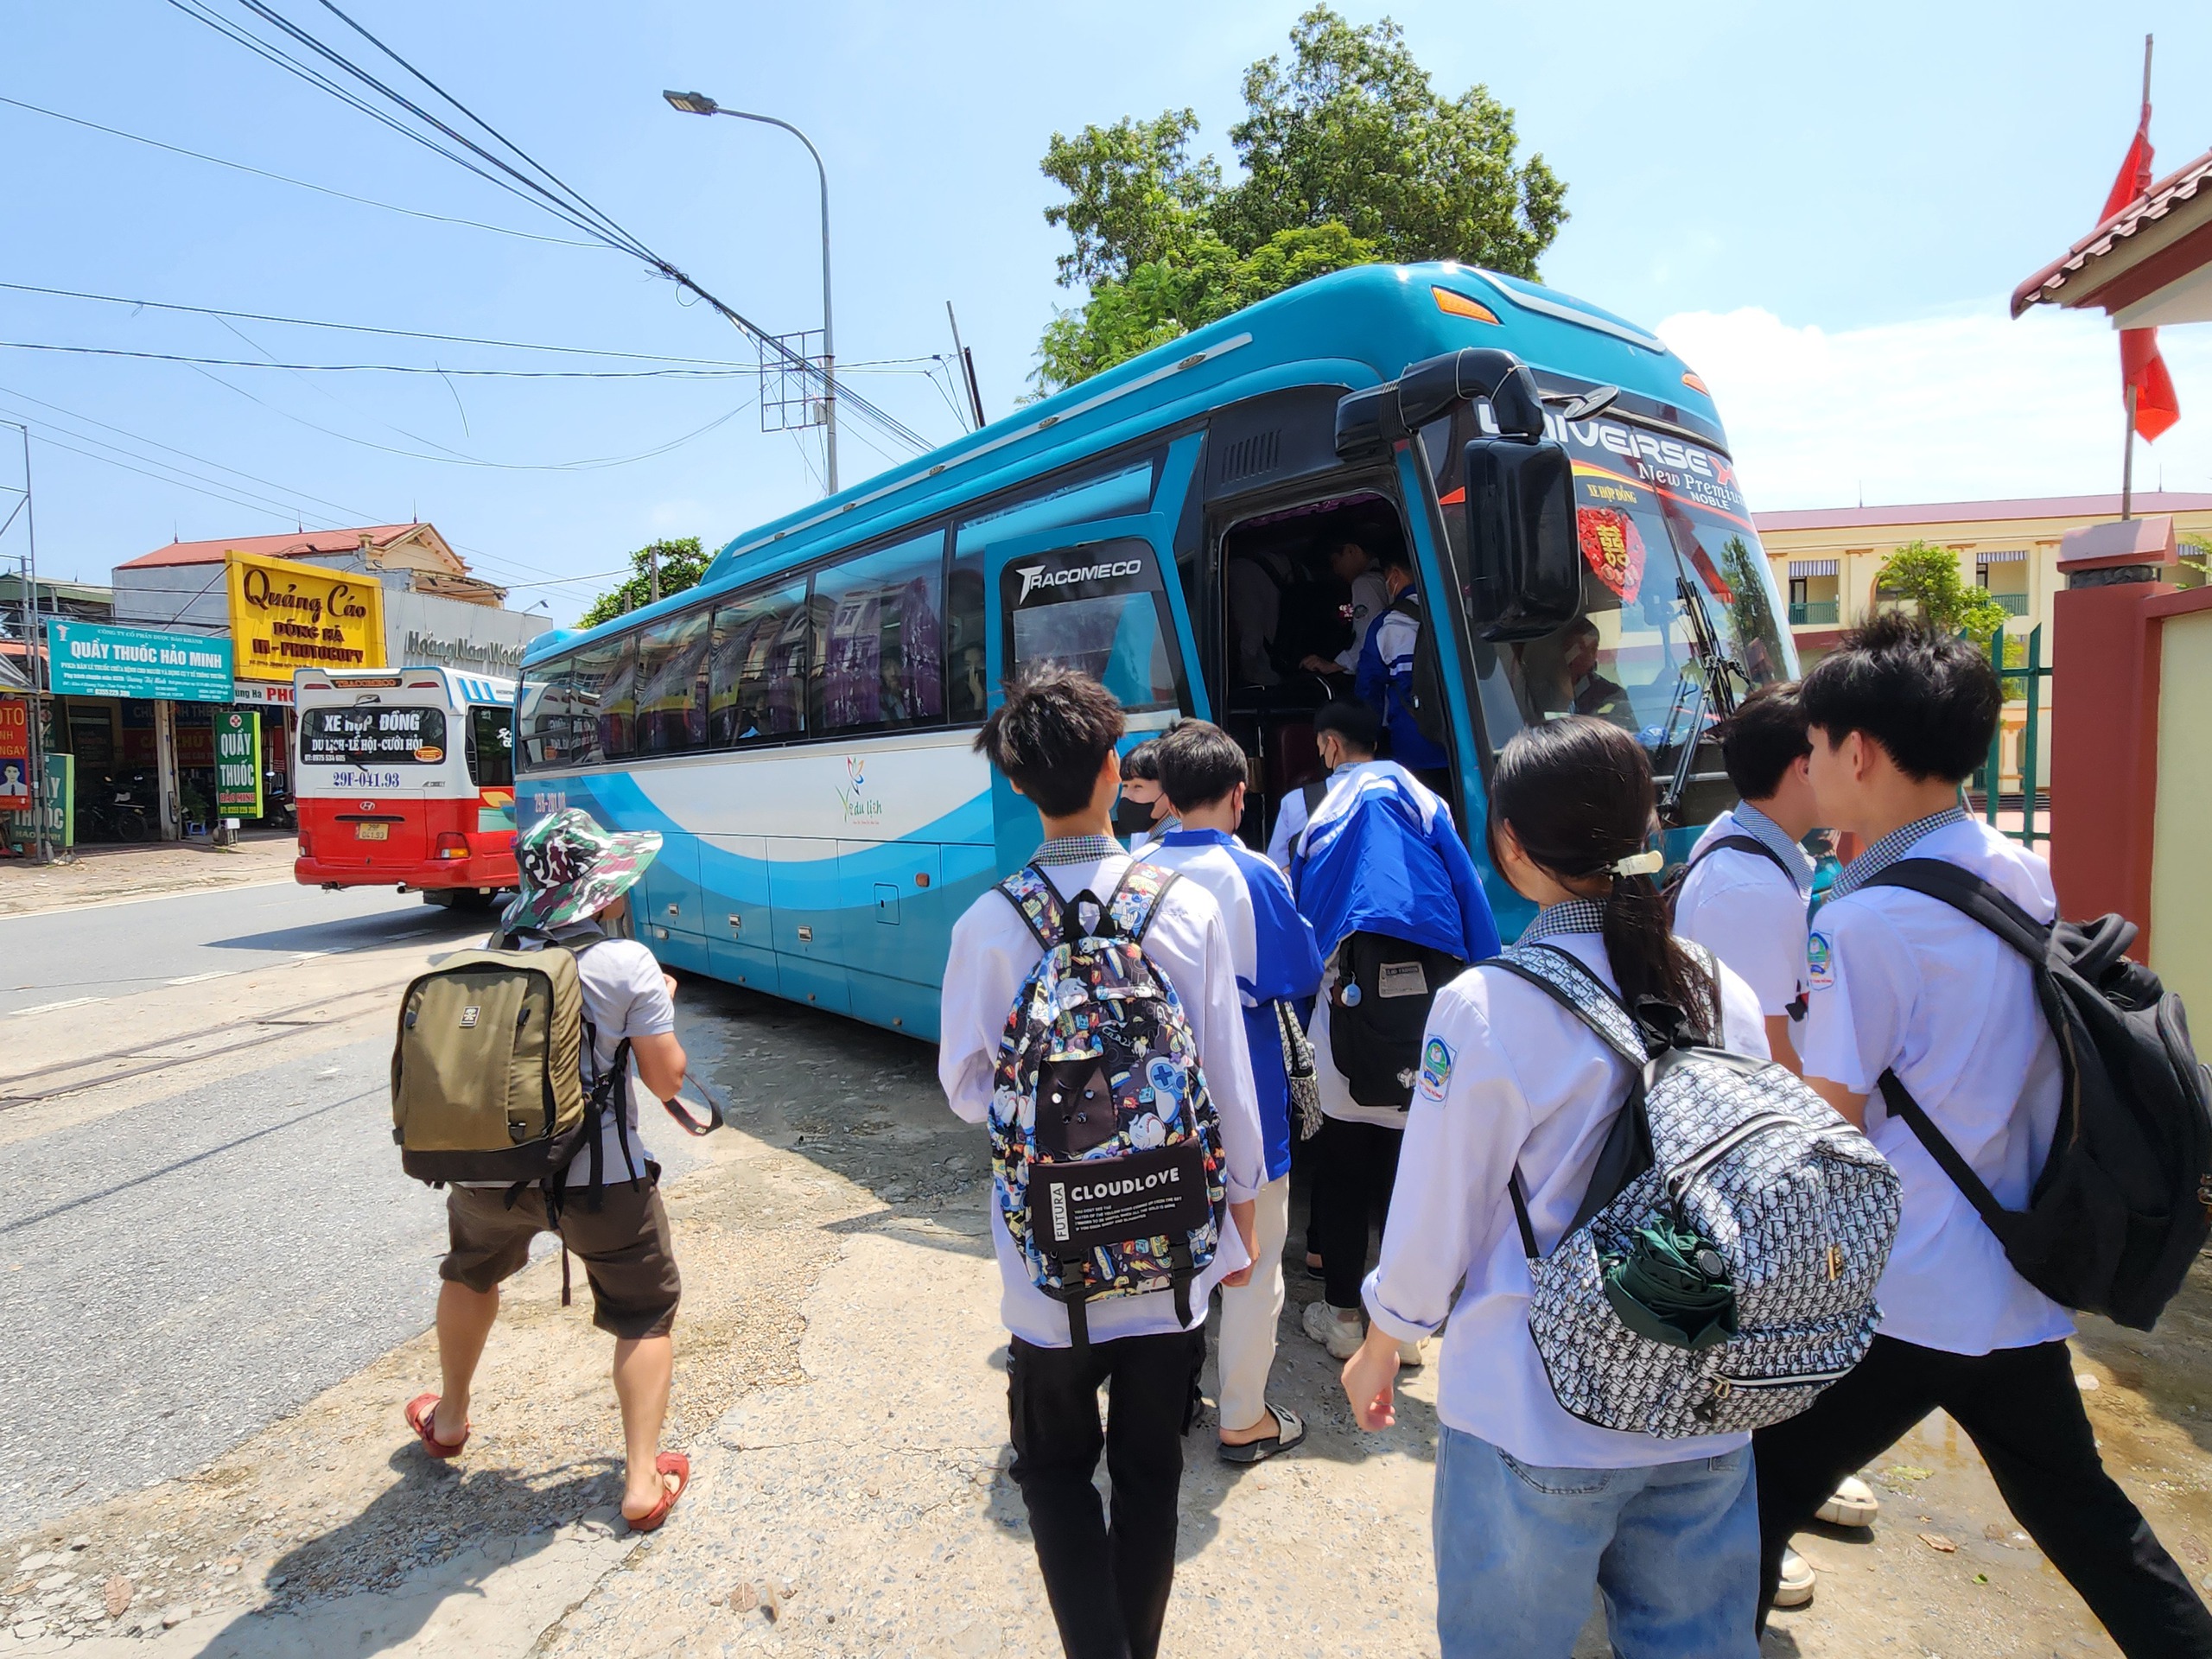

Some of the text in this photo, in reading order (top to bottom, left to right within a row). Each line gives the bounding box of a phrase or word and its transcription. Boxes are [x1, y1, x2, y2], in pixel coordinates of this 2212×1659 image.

[1637, 462, 1680, 487] New
[1586, 484, 1599, 497] XE
[1691, 492, 1732, 510] NOBLE
[1016, 560, 1142, 606] TRACOMECO
[244, 569, 367, 623] Quảng Cáo
[323, 625, 344, 642] HÀ
[71, 638, 222, 669] QUẦY THUỐC HẢO MINH
[281, 642, 364, 663] PHOTOCOPY
[455, 638, 486, 662] Nam
[487, 642, 525, 665] Wedd
[324, 715, 341, 732] XE
[379, 710, 420, 732] ĐỒNG
[221, 728, 251, 759] QUẦY
[312, 740, 323, 751] DU
[220, 760, 254, 786] THUỐC
[334, 772, 399, 787] 29F-041.93
[220, 790, 255, 803] HẢO MINH
[855, 801, 864, 816] du
[867, 799, 881, 818] lịch
[1071, 1167, 1180, 1201] CLOUDLOVE
[1052, 1186, 1067, 1237] FUTURA
